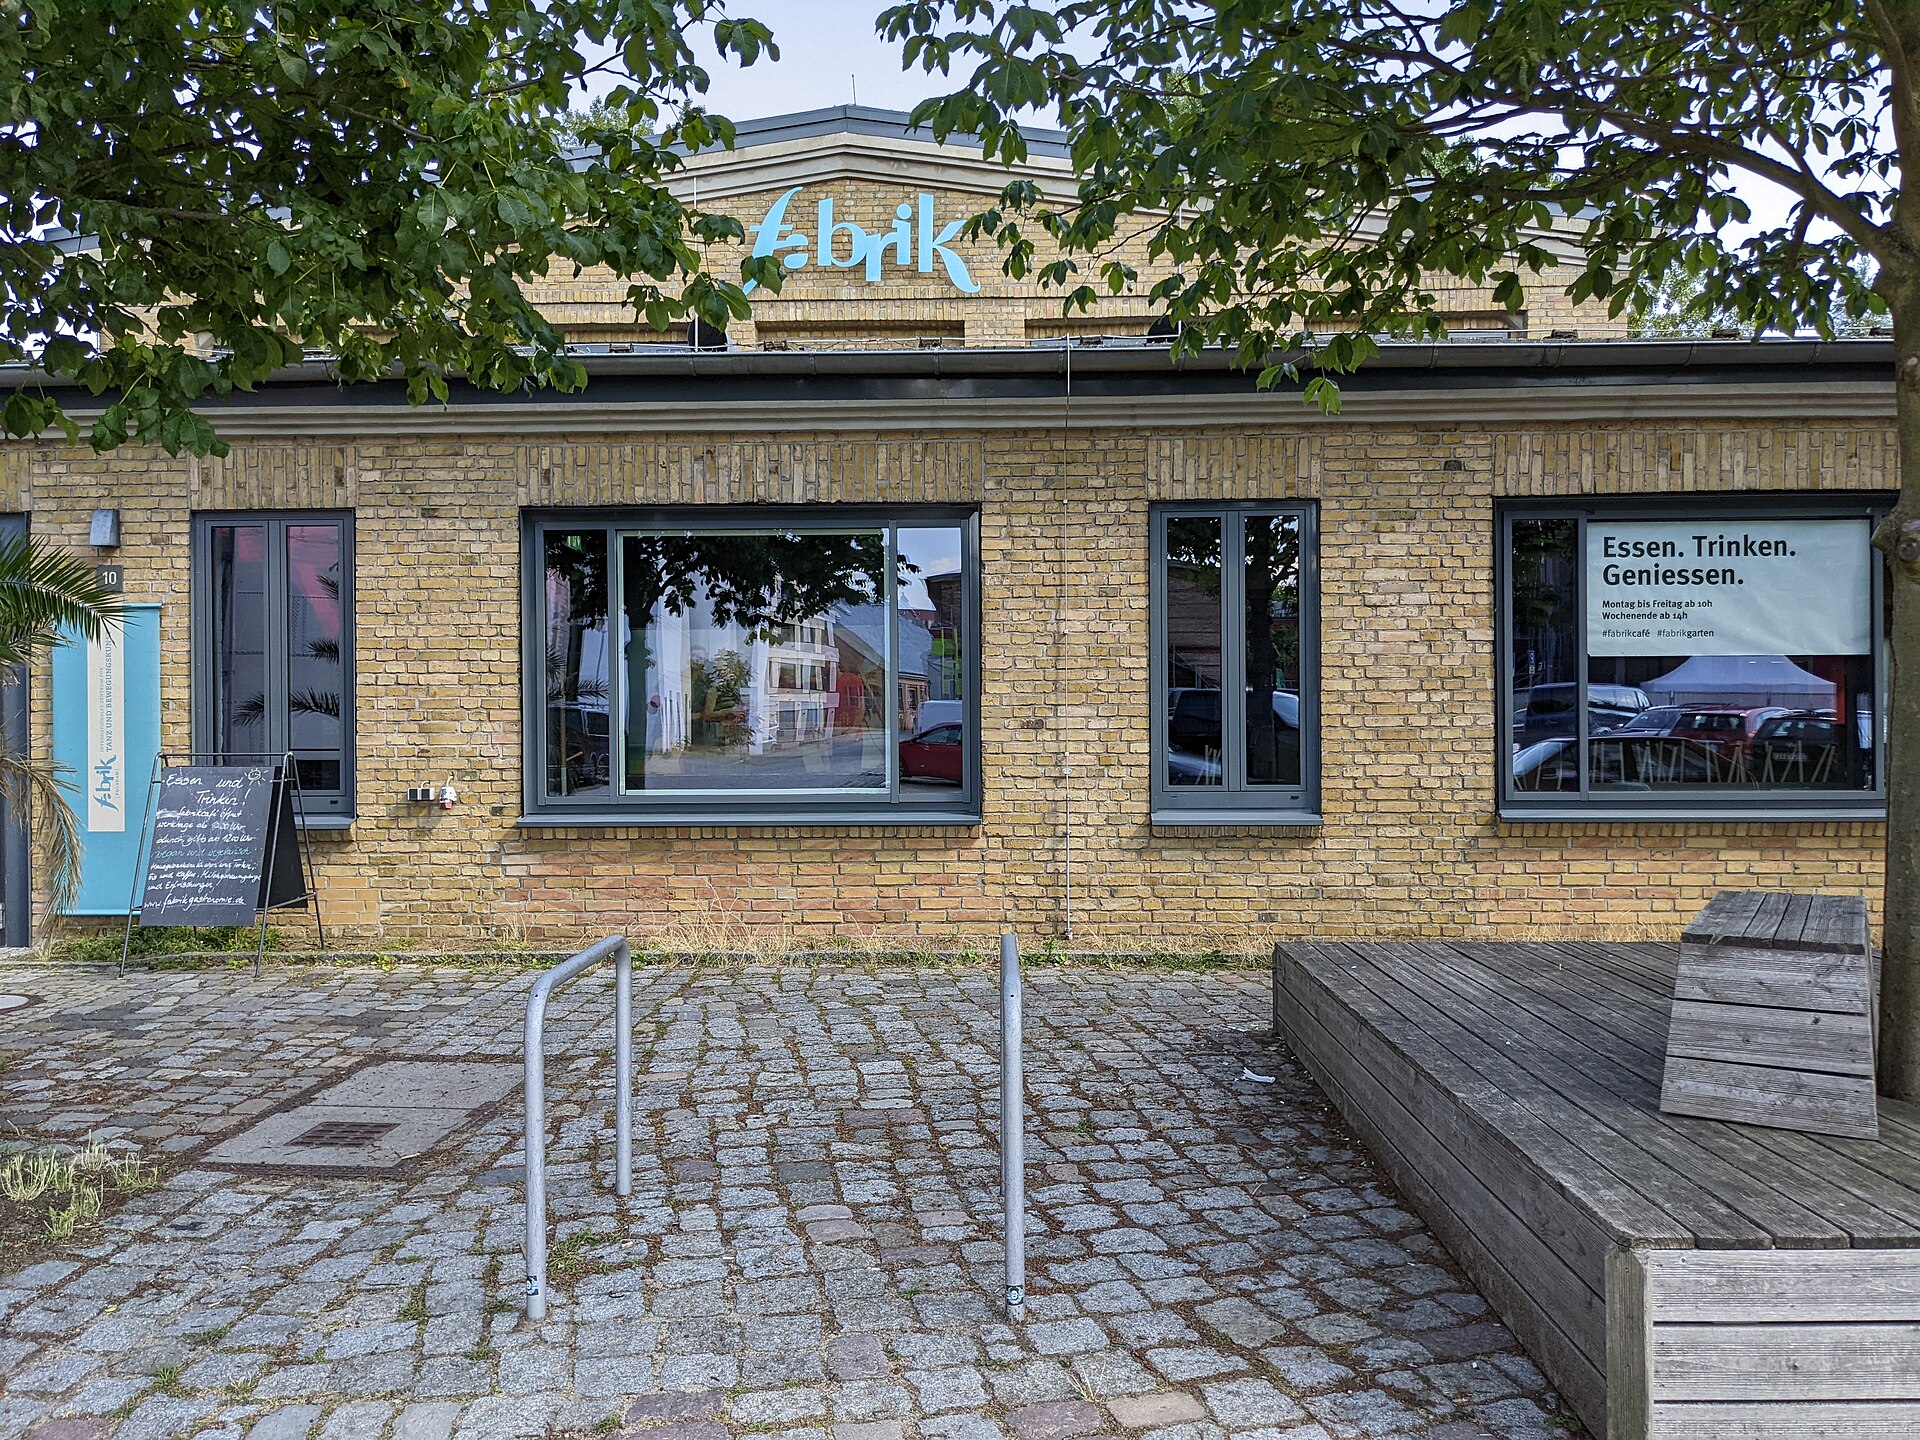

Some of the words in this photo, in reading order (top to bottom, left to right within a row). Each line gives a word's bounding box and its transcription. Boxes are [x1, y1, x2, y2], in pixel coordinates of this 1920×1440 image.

[743, 186, 981, 295] fabrik
[1603, 536, 1684, 558] Essen.
[1692, 534, 1796, 557] Trinken.
[103, 571, 117, 585] 10
[1603, 563, 1744, 585] Geniessen.
[1602, 600, 1635, 609] Montag
[1637, 600, 1650, 608] bis
[1653, 599, 1682, 609] Freitag
[1684, 600, 1695, 608] ab
[1697, 600, 1713, 608] 10h
[1602, 611, 1658, 620] Wochenende
[1659, 611, 1671, 619] ab
[1672, 612, 1688, 621] 14h
[1602, 629, 1651, 638] #fabrikcafé
[1657, 629, 1714, 639] #fabrikgarten
[93, 754, 119, 813] fabrik
[166, 773, 204, 787] Essen
[215, 777, 244, 789] und
[147, 882, 163, 891] und
